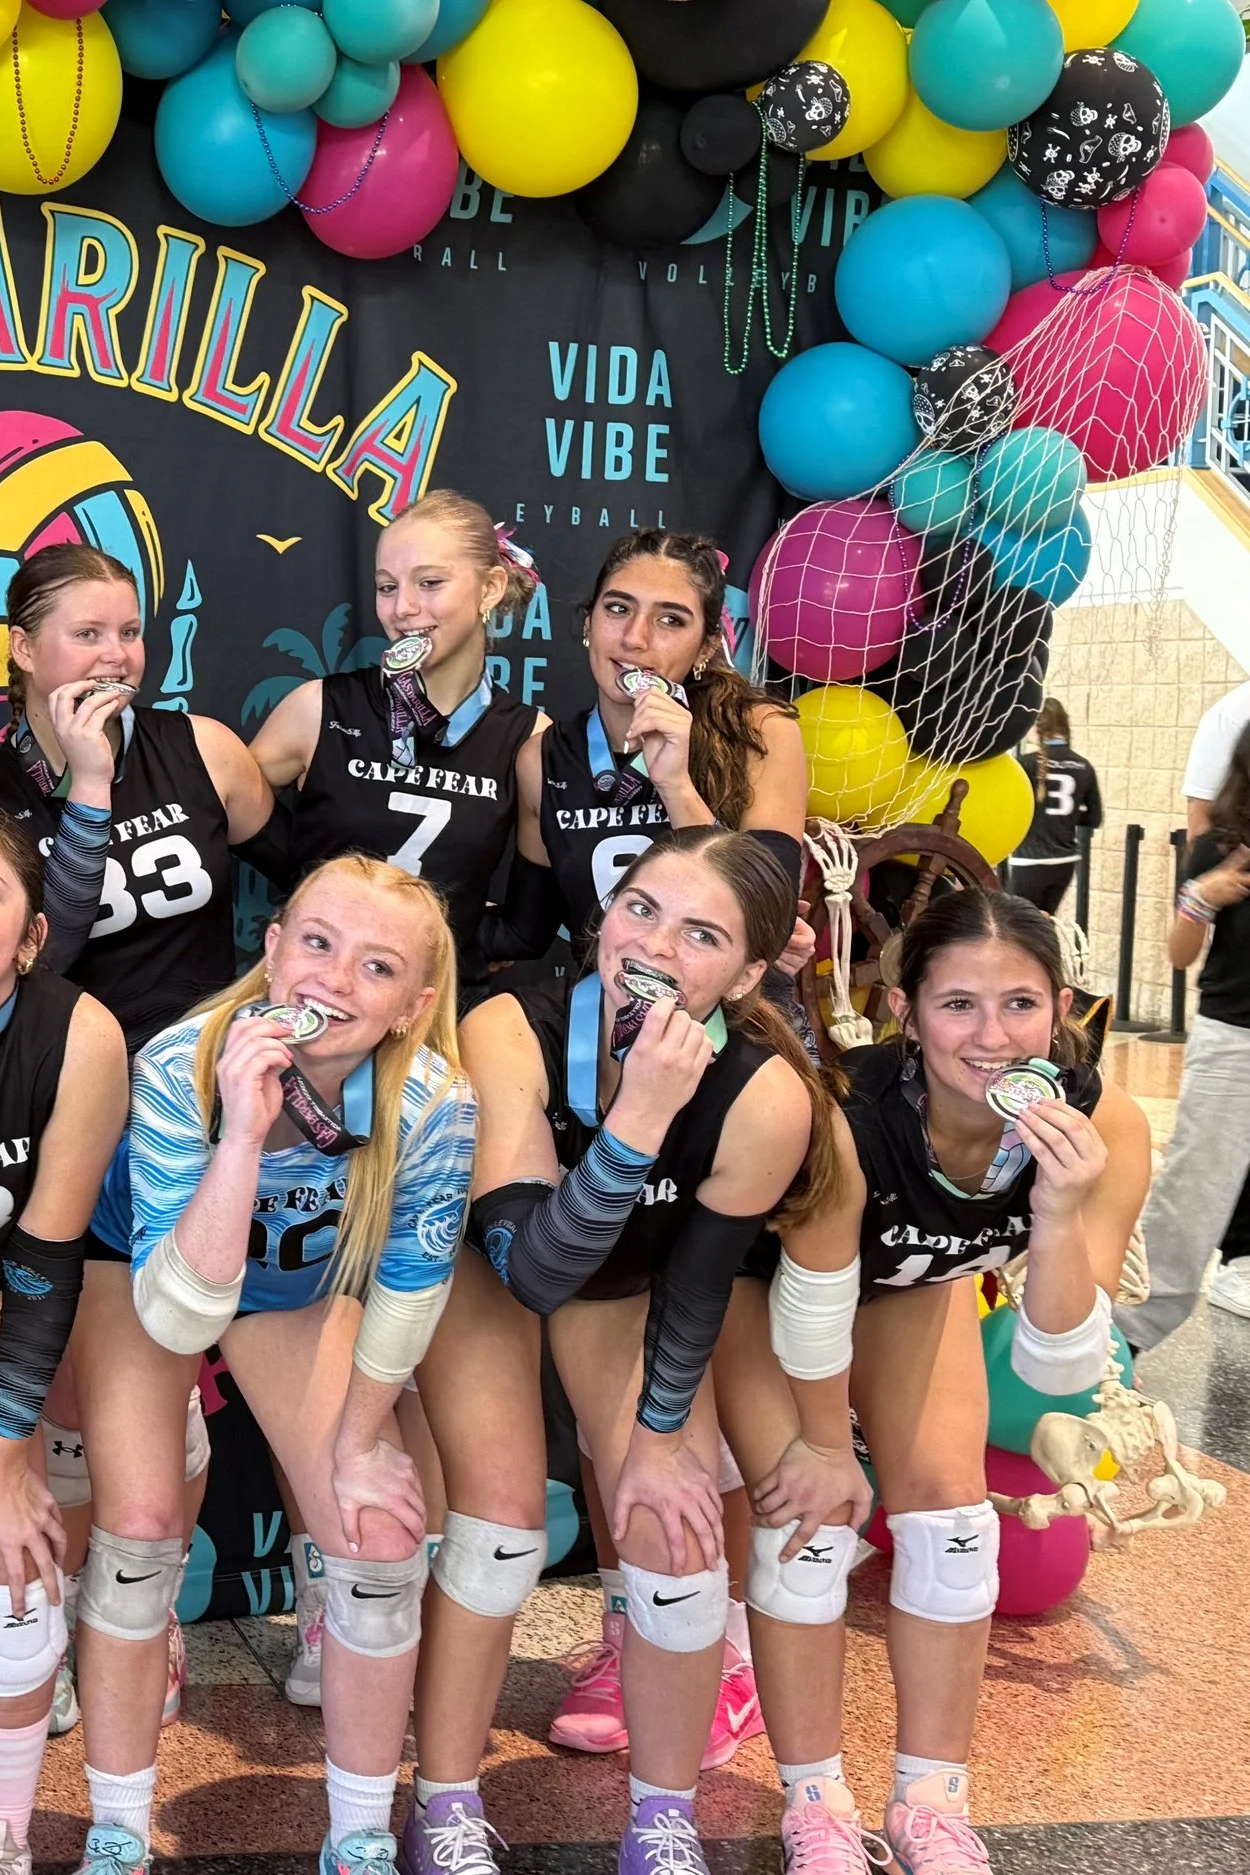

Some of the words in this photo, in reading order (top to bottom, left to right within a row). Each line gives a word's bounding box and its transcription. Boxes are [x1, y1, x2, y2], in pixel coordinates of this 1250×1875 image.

[548, 341, 672, 407] VIDA
[545, 418, 670, 482] VIBE
[348, 758, 424, 785] CAPE
[425, 767, 498, 801] FEAR
[114, 803, 190, 842] FEAR
[387, 791, 453, 877] 7
[556, 806, 625, 830] CAPE
